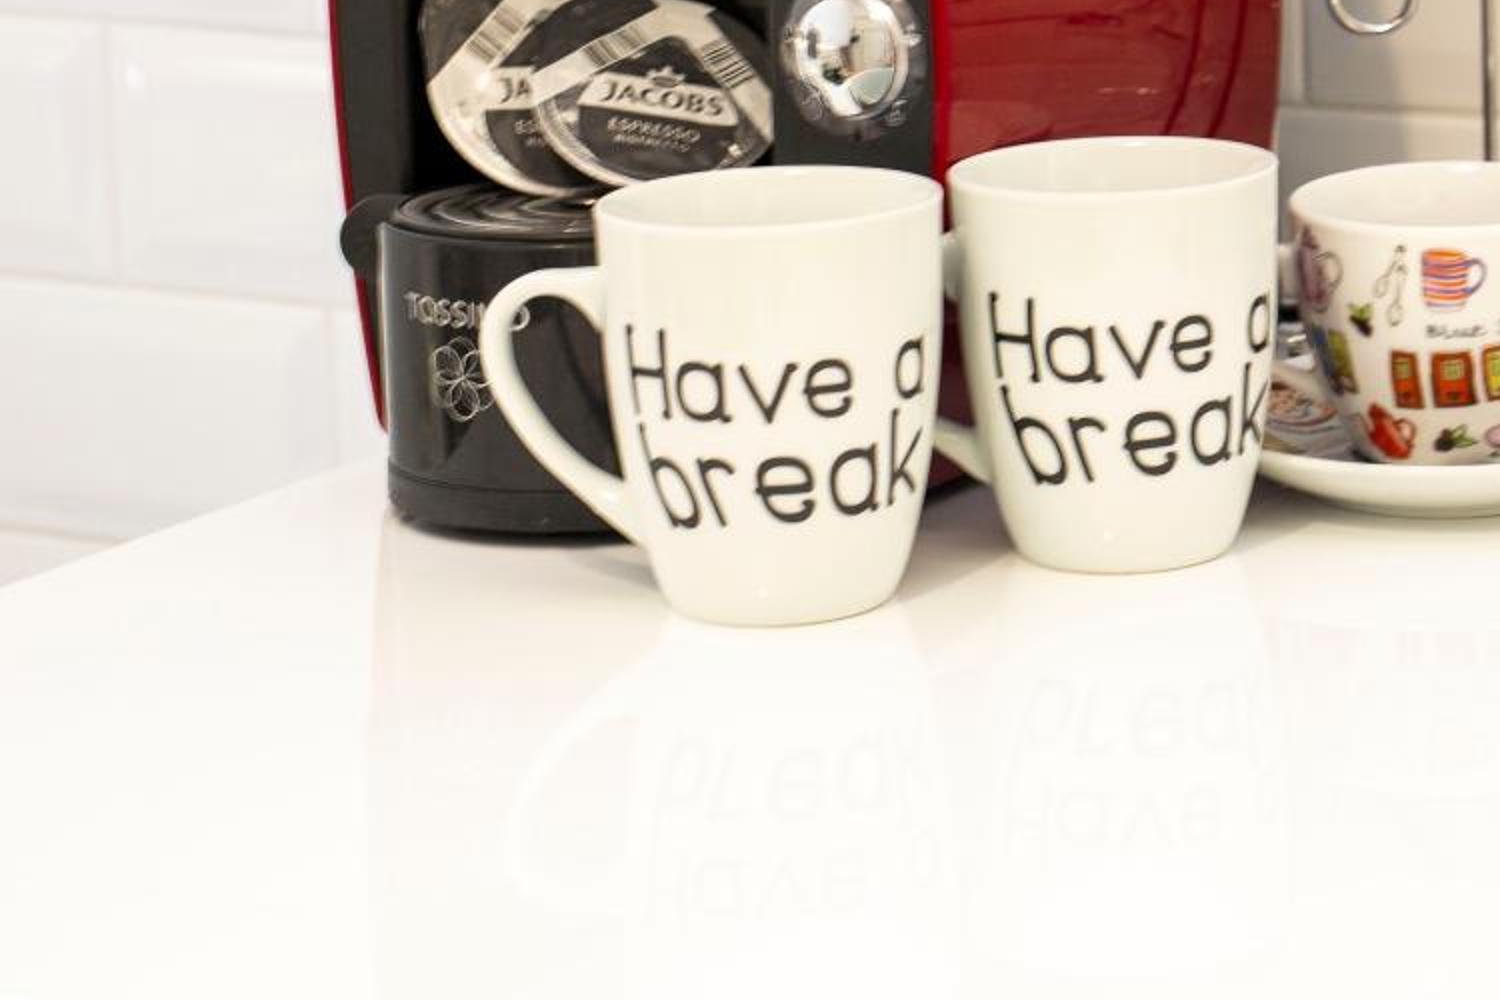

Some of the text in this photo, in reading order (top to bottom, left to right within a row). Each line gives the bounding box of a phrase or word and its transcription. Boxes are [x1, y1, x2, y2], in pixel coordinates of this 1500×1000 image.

[600, 78, 729, 119] JACOBS
[624, 323, 926, 424] Have a
[988, 291, 1214, 384] Have
[638, 408, 925, 530] break
[1001, 362, 1267, 487] break
